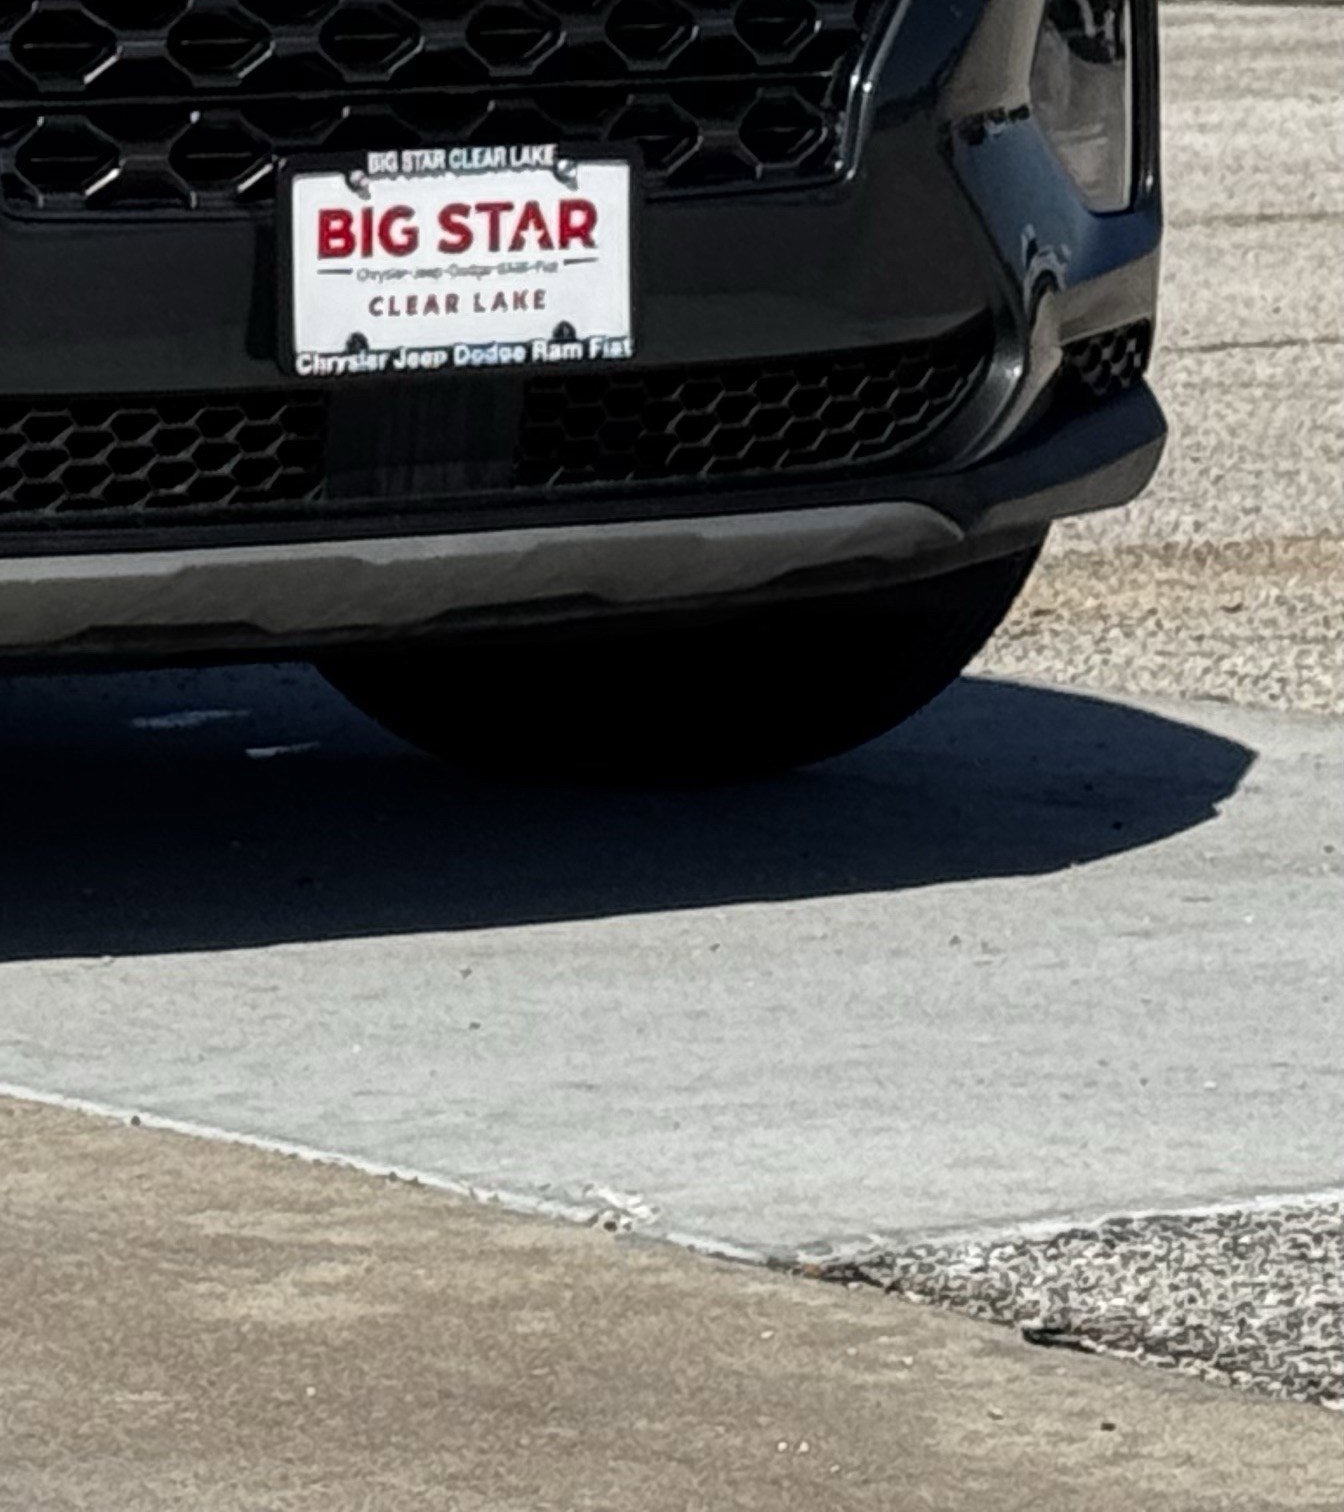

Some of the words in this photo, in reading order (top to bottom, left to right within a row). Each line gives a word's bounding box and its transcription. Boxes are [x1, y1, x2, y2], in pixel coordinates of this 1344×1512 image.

[367, 150, 398, 175] BIG
[401, 148, 447, 172] STAR
[448, 145, 507, 169] CLEAR
[510, 144, 558, 167] LAKE
[317, 205, 419, 260] BIG
[437, 199, 598, 254] STAR
[368, 293, 460, 317] CLEAR
[473, 289, 547, 313] LAKE
[393, 347, 448, 370] Jeep
[453, 342, 527, 367] Dodge
[532, 339, 584, 362] Ram
[589, 336, 634, 360] Fiat
